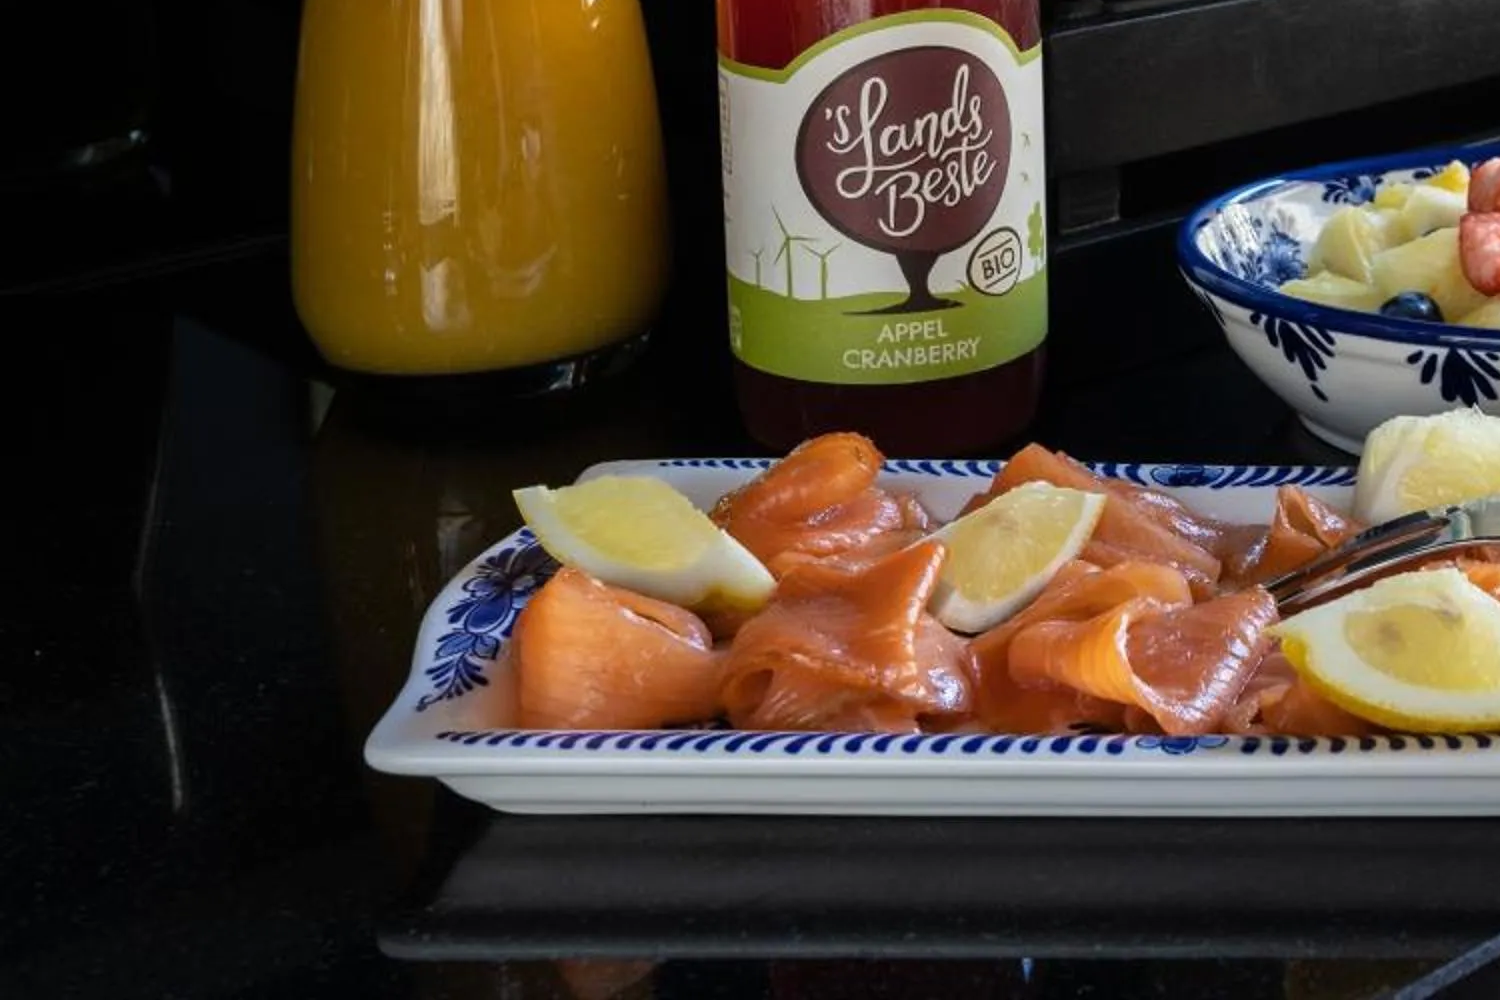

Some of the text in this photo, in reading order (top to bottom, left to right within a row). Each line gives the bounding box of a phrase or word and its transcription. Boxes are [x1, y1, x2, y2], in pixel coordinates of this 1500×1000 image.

[875, 142, 996, 237] Beste
[982, 246, 1016, 281] BIO
[877, 319, 948, 343] APPEL
[842, 337, 981, 370] CRANBERRY
